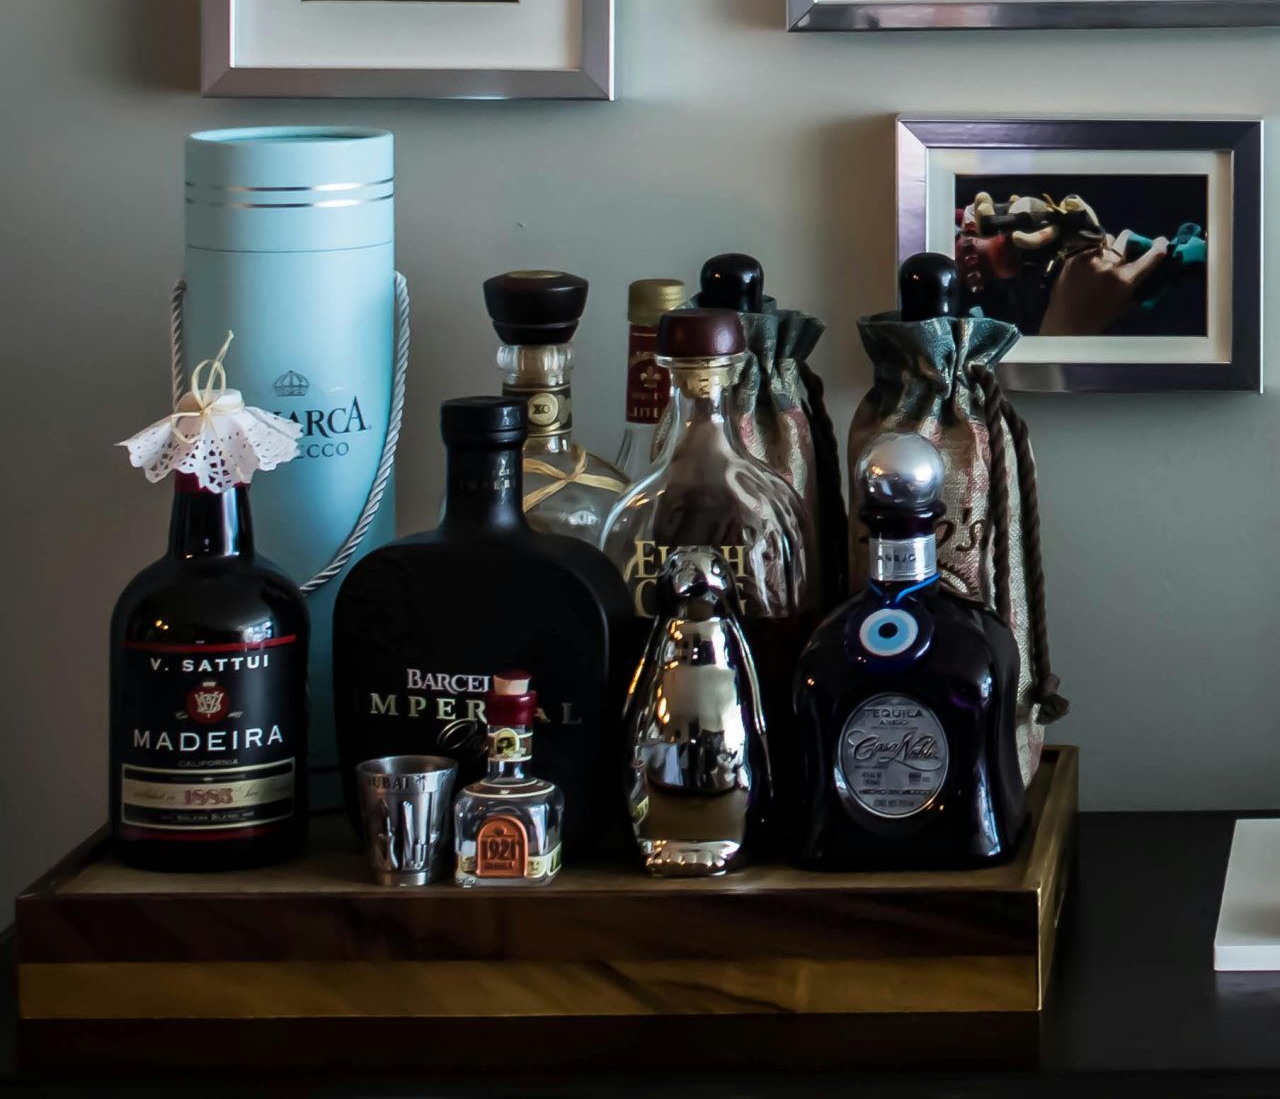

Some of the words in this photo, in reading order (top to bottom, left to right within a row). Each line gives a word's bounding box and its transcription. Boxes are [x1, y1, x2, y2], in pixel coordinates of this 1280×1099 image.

[150, 657, 169, 671] V.
[182, 654, 269, 672] SATTUI
[864, 708, 924, 718] TEQUILA
[133, 724, 284, 751] MADEIRA
